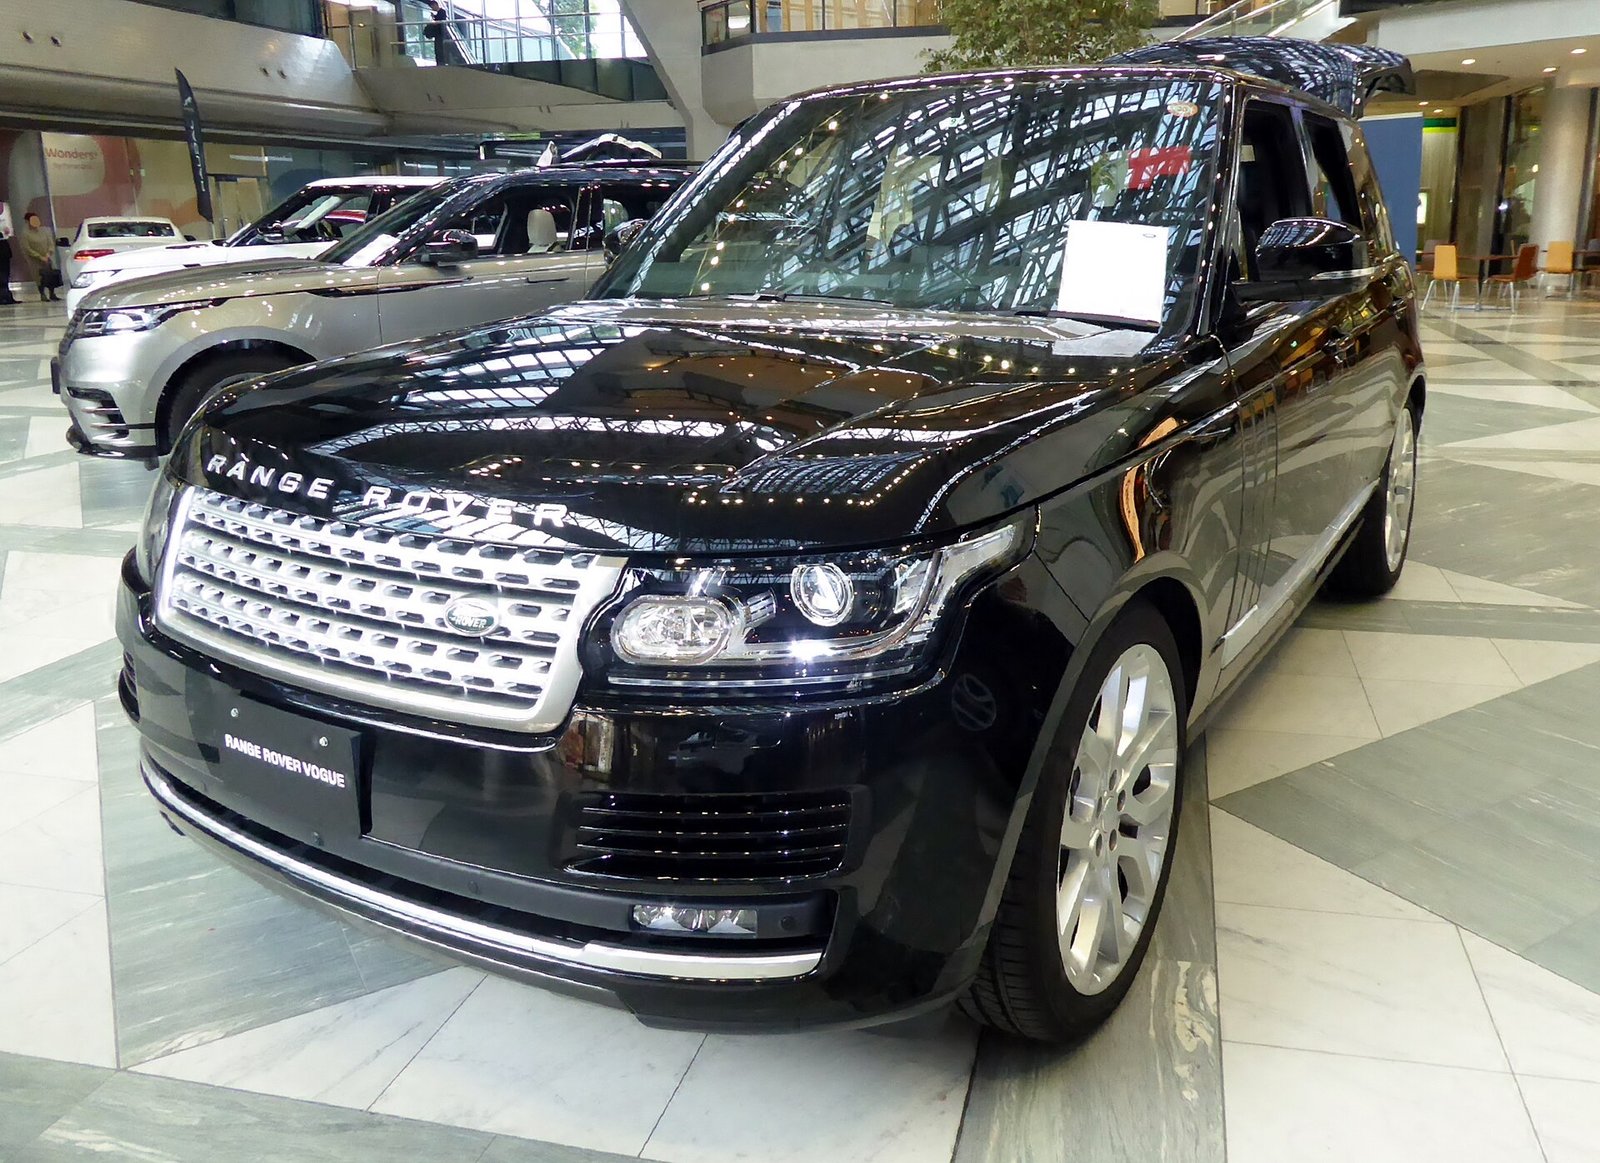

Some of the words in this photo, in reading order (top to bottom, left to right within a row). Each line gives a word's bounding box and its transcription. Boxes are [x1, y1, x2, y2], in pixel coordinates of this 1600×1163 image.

[206, 453, 335, 500] RANGE
[363, 486, 568, 527] ROVER
[455, 615, 487, 628] ROVER
[225, 734, 261, 759] RANGE
[262, 748, 302, 773] ROVER
[302, 762, 345, 788] VOGUE
